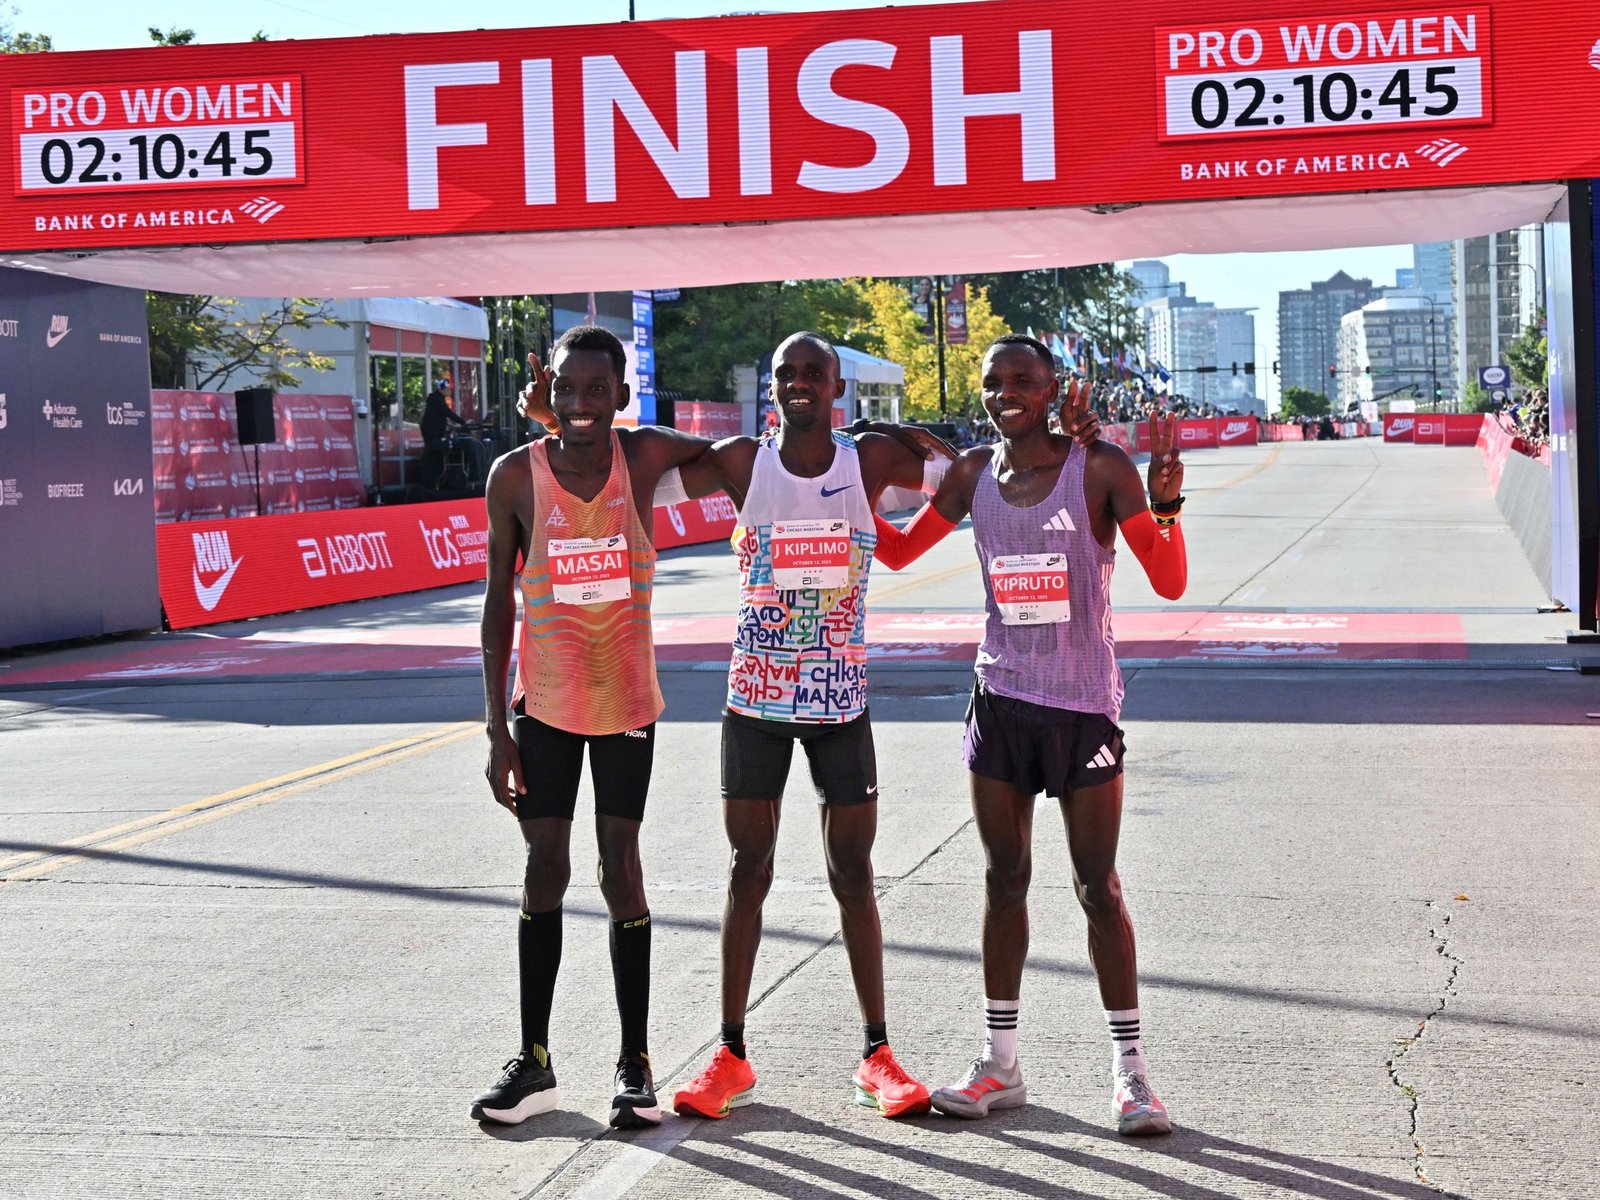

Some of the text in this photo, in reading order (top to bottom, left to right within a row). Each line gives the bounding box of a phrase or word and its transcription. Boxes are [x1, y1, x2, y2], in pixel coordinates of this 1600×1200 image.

[1168, 14, 1476, 69] PRO WOMEN
[24, 82, 292, 128] PRO WOMEN
[1191, 66, 1459, 129] 02:10:45
[403, 29, 1057, 210] FINISH
[41, 130, 273, 184] 02:10:45
[1180, 152, 1410, 180] BANK OF AMERICA
[35, 208, 235, 232] BANK OF AMERICA
[50, 314, 69, 333] RUN
[107, 402, 123, 425] tcs
[1393, 418, 1414, 429] RUN
[1226, 422, 1249, 433] RUN
[48, 483, 84, 498] BIOFREEZE
[192, 530, 233, 573] RUN
[324, 530, 394, 576] ABBOTT
[419, 519, 461, 569] tcs
[774, 541, 848, 560] J KIPLIMO
[556, 552, 623, 576] MASAI
[571, 574, 592, 582] OCTOBER
[993, 575, 1065, 592] KIPRUTO
[625, 730, 647, 739] HOKA
